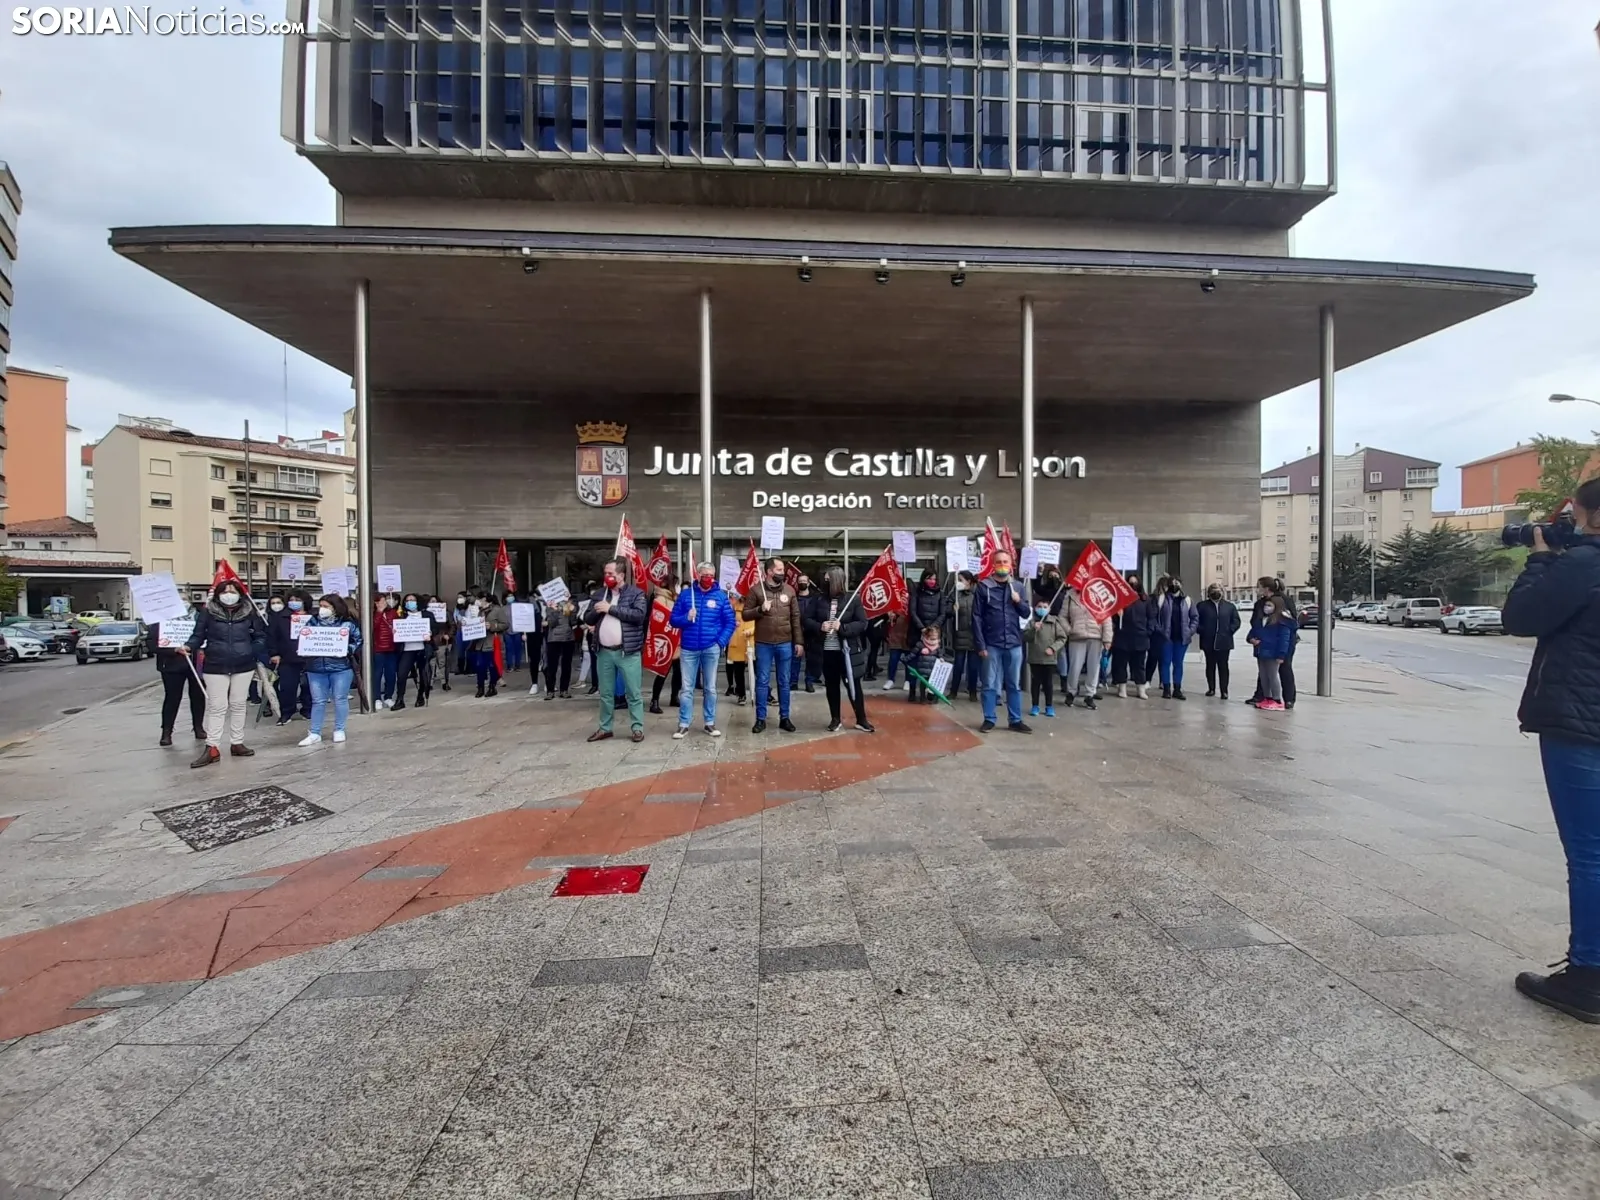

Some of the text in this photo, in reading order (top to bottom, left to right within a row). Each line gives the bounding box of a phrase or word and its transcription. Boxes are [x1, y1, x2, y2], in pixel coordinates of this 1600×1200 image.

[644, 446, 755, 476] Junta
[765, 447, 813, 476] de
[824, 447, 955, 477] Castilla
[963, 454, 988, 485] y
[752, 491, 985, 513] Delegación Territorial
[870, 581, 888, 606] UGT
[1087, 580, 1116, 607] UGT
